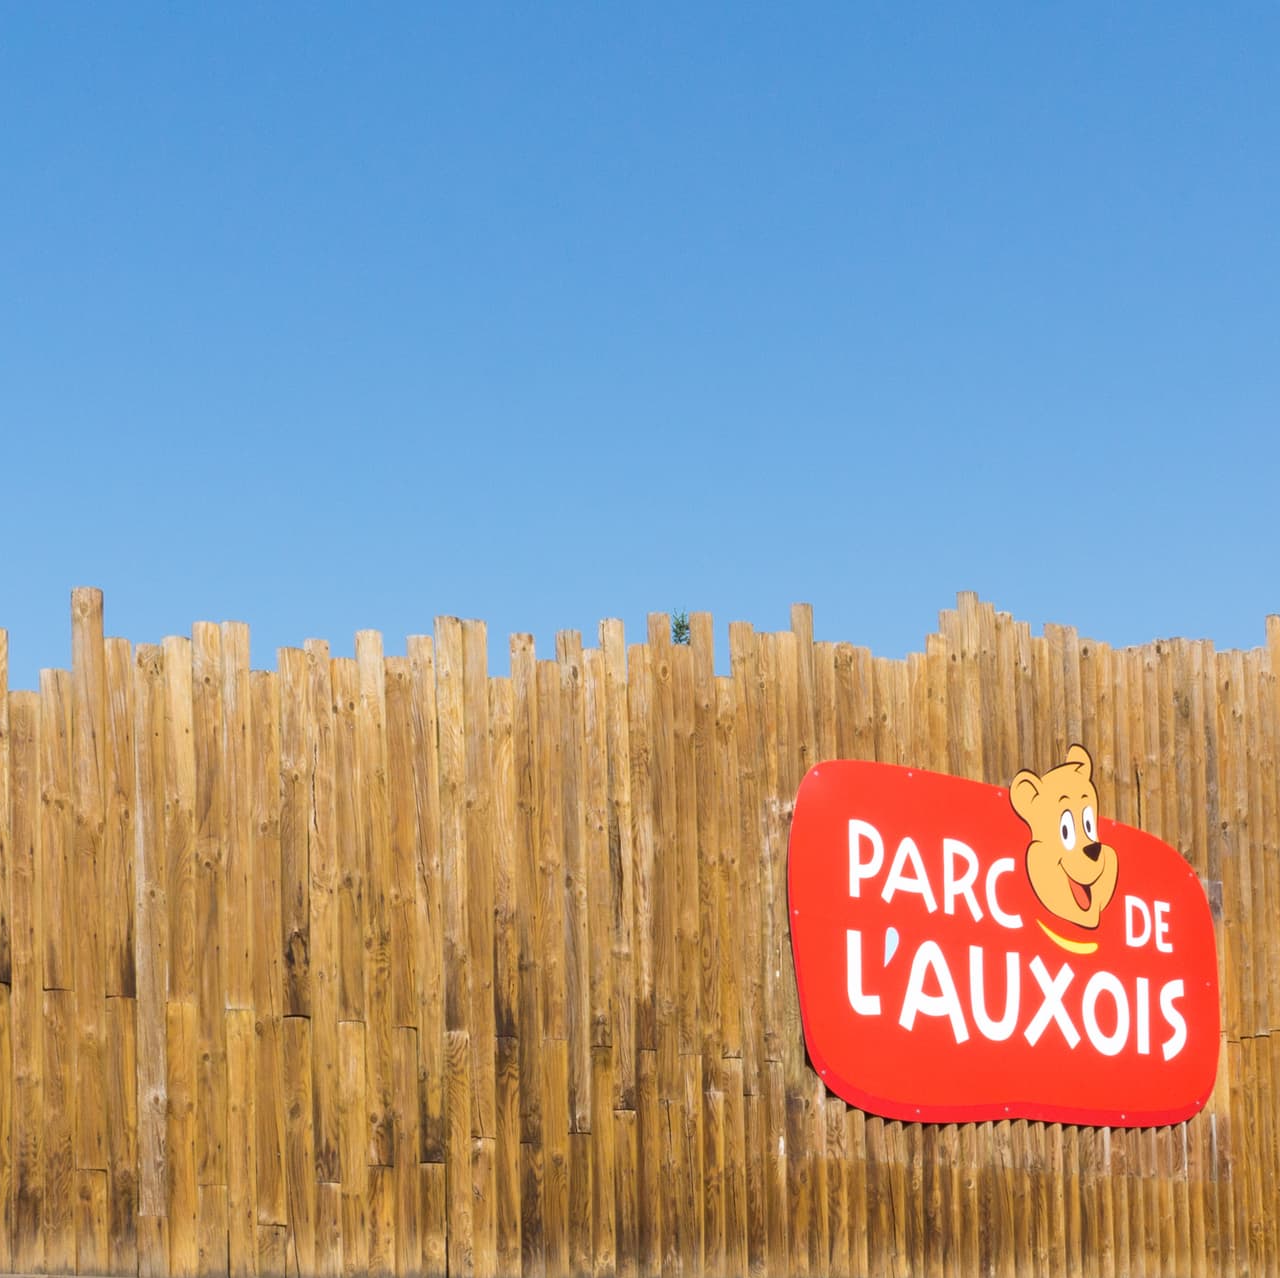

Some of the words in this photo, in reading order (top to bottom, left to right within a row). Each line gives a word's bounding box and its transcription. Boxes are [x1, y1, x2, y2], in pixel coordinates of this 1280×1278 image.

[848, 818, 1023, 928] PARC
[1124, 895, 1173, 953] DE
[846, 927, 1187, 1061] L'AUXOIS
